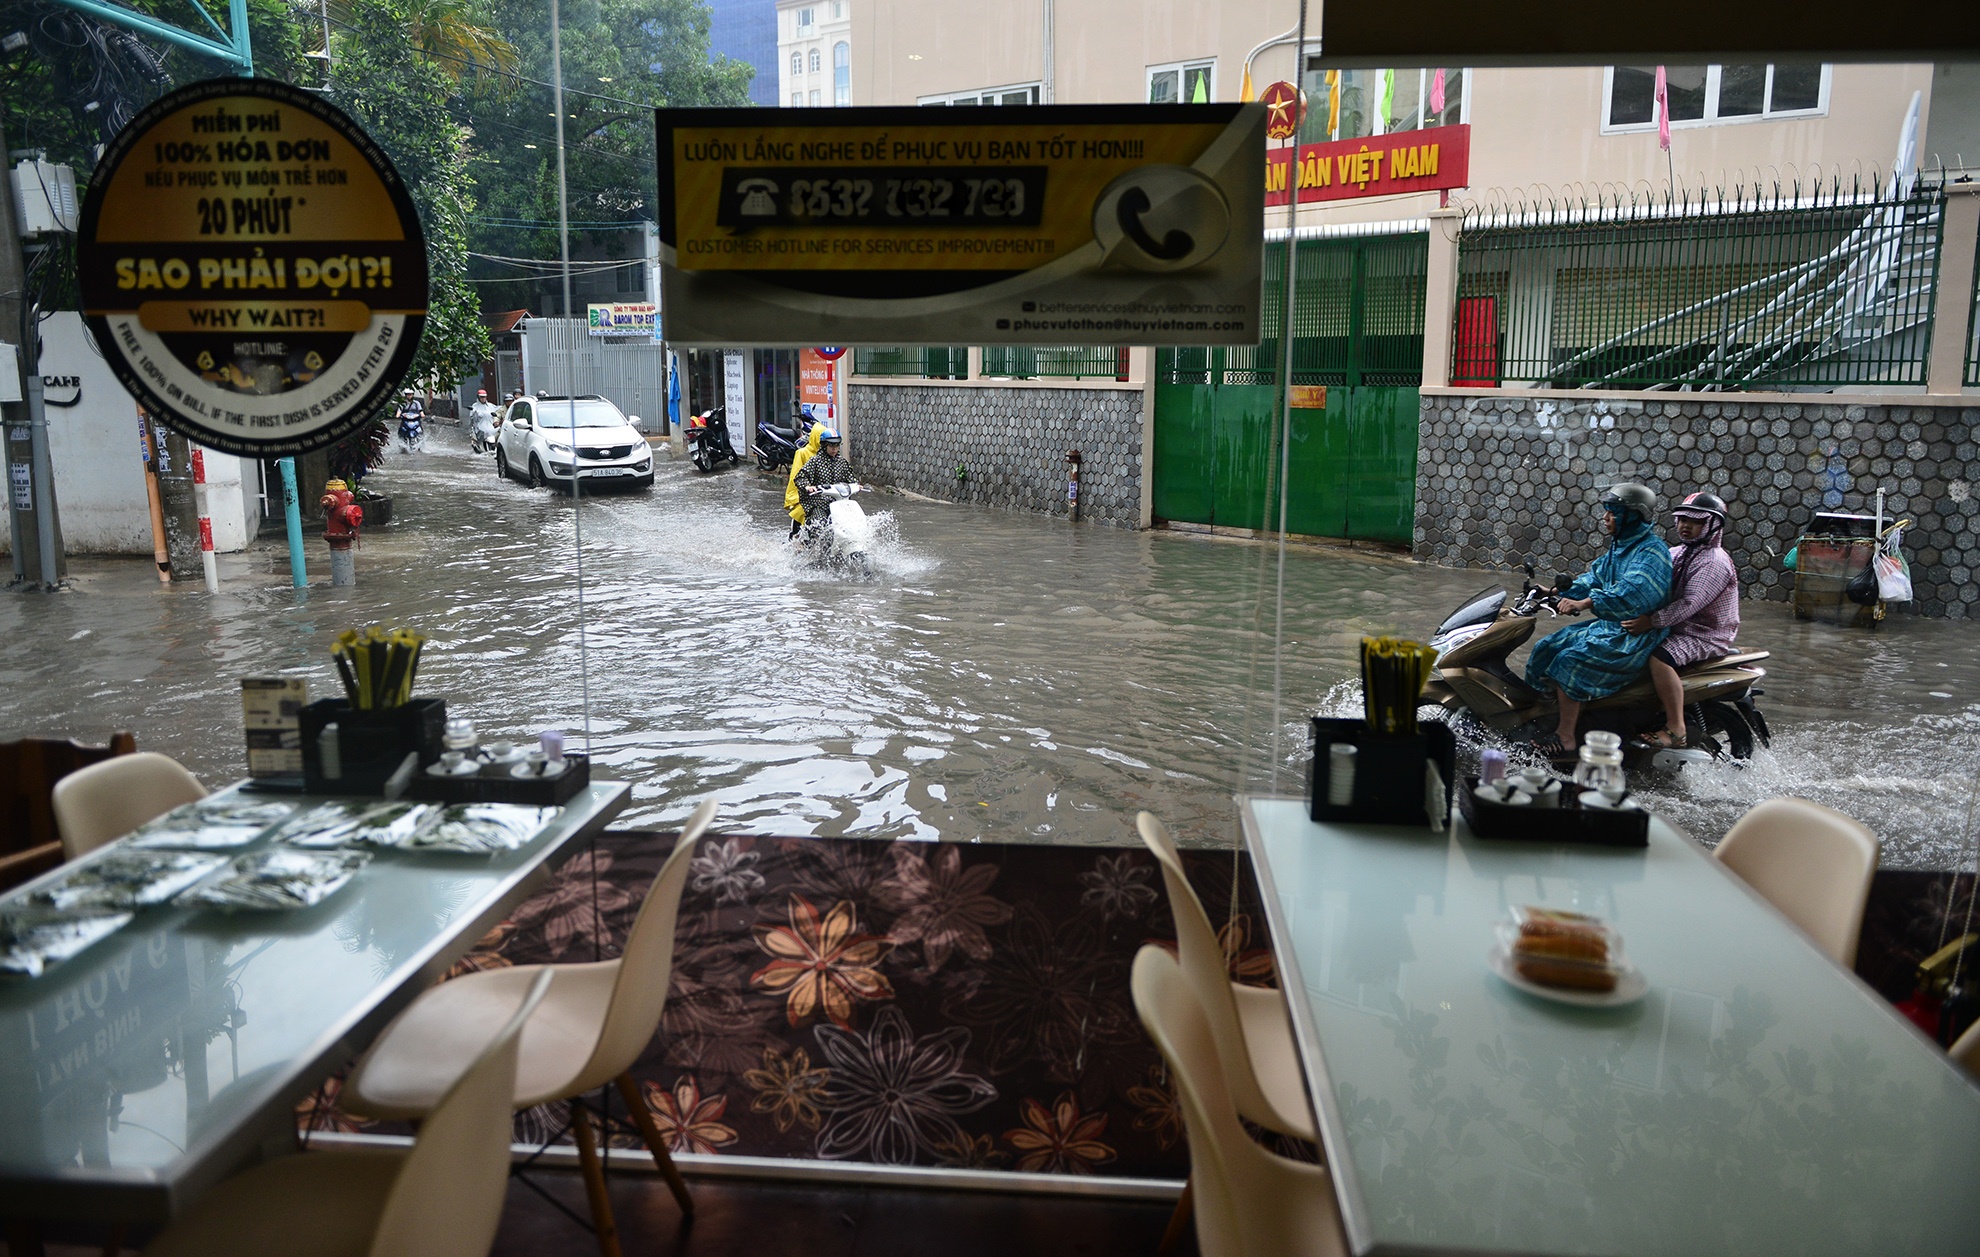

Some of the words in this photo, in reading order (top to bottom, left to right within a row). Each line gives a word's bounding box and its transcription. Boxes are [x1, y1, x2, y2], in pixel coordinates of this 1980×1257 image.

[153, 142, 212, 164] 100%
[217, 135, 270, 163] HÓA
[278, 140, 330, 162] ĐƠN
[684, 137, 738, 162] LUÔN
[742, 134, 794, 161] LẮNG
[799, 141, 855, 161] NGHE
[861, 132, 888, 161] ĐỂ
[893, 141, 947, 166] PHỤC
[953, 141, 982, 166] VỤ
[988, 140, 1031, 166] BẠN
[1037, 133, 1078, 160] TỐT
[1083, 138, 1145, 160] HƠN!!!
[1337, 145, 1385, 190] VIỆT
[1391, 143, 1439, 180] NAM
[197, 198, 226, 235] 20
[686, 239, 765, 254] CUSTOMER
[767, 239, 829, 254] HOTLINE
[832, 238, 862, 254] FOR
[867, 238, 934, 254] SERVICES
[115, 257, 190, 290] SAO
[200, 247, 287, 290] PHẢI
[295, 254, 393, 297] ĐỢI?!
[188, 308, 246, 328] WHY
[251, 308, 325, 328] WAIT?!
[116, 320, 143, 357] FREE
[137, 354, 169, 389] 100%
[164, 381, 184, 401] ON
[209, 406, 222, 419] IF
[223, 410, 244, 426] THE
[249, 412, 282, 428] FIRST
[282, 406, 311, 427] DISH
[308, 402, 322, 418] IS
[319, 375, 361, 412] SERVED
[353, 343, 387, 383] AFTER
